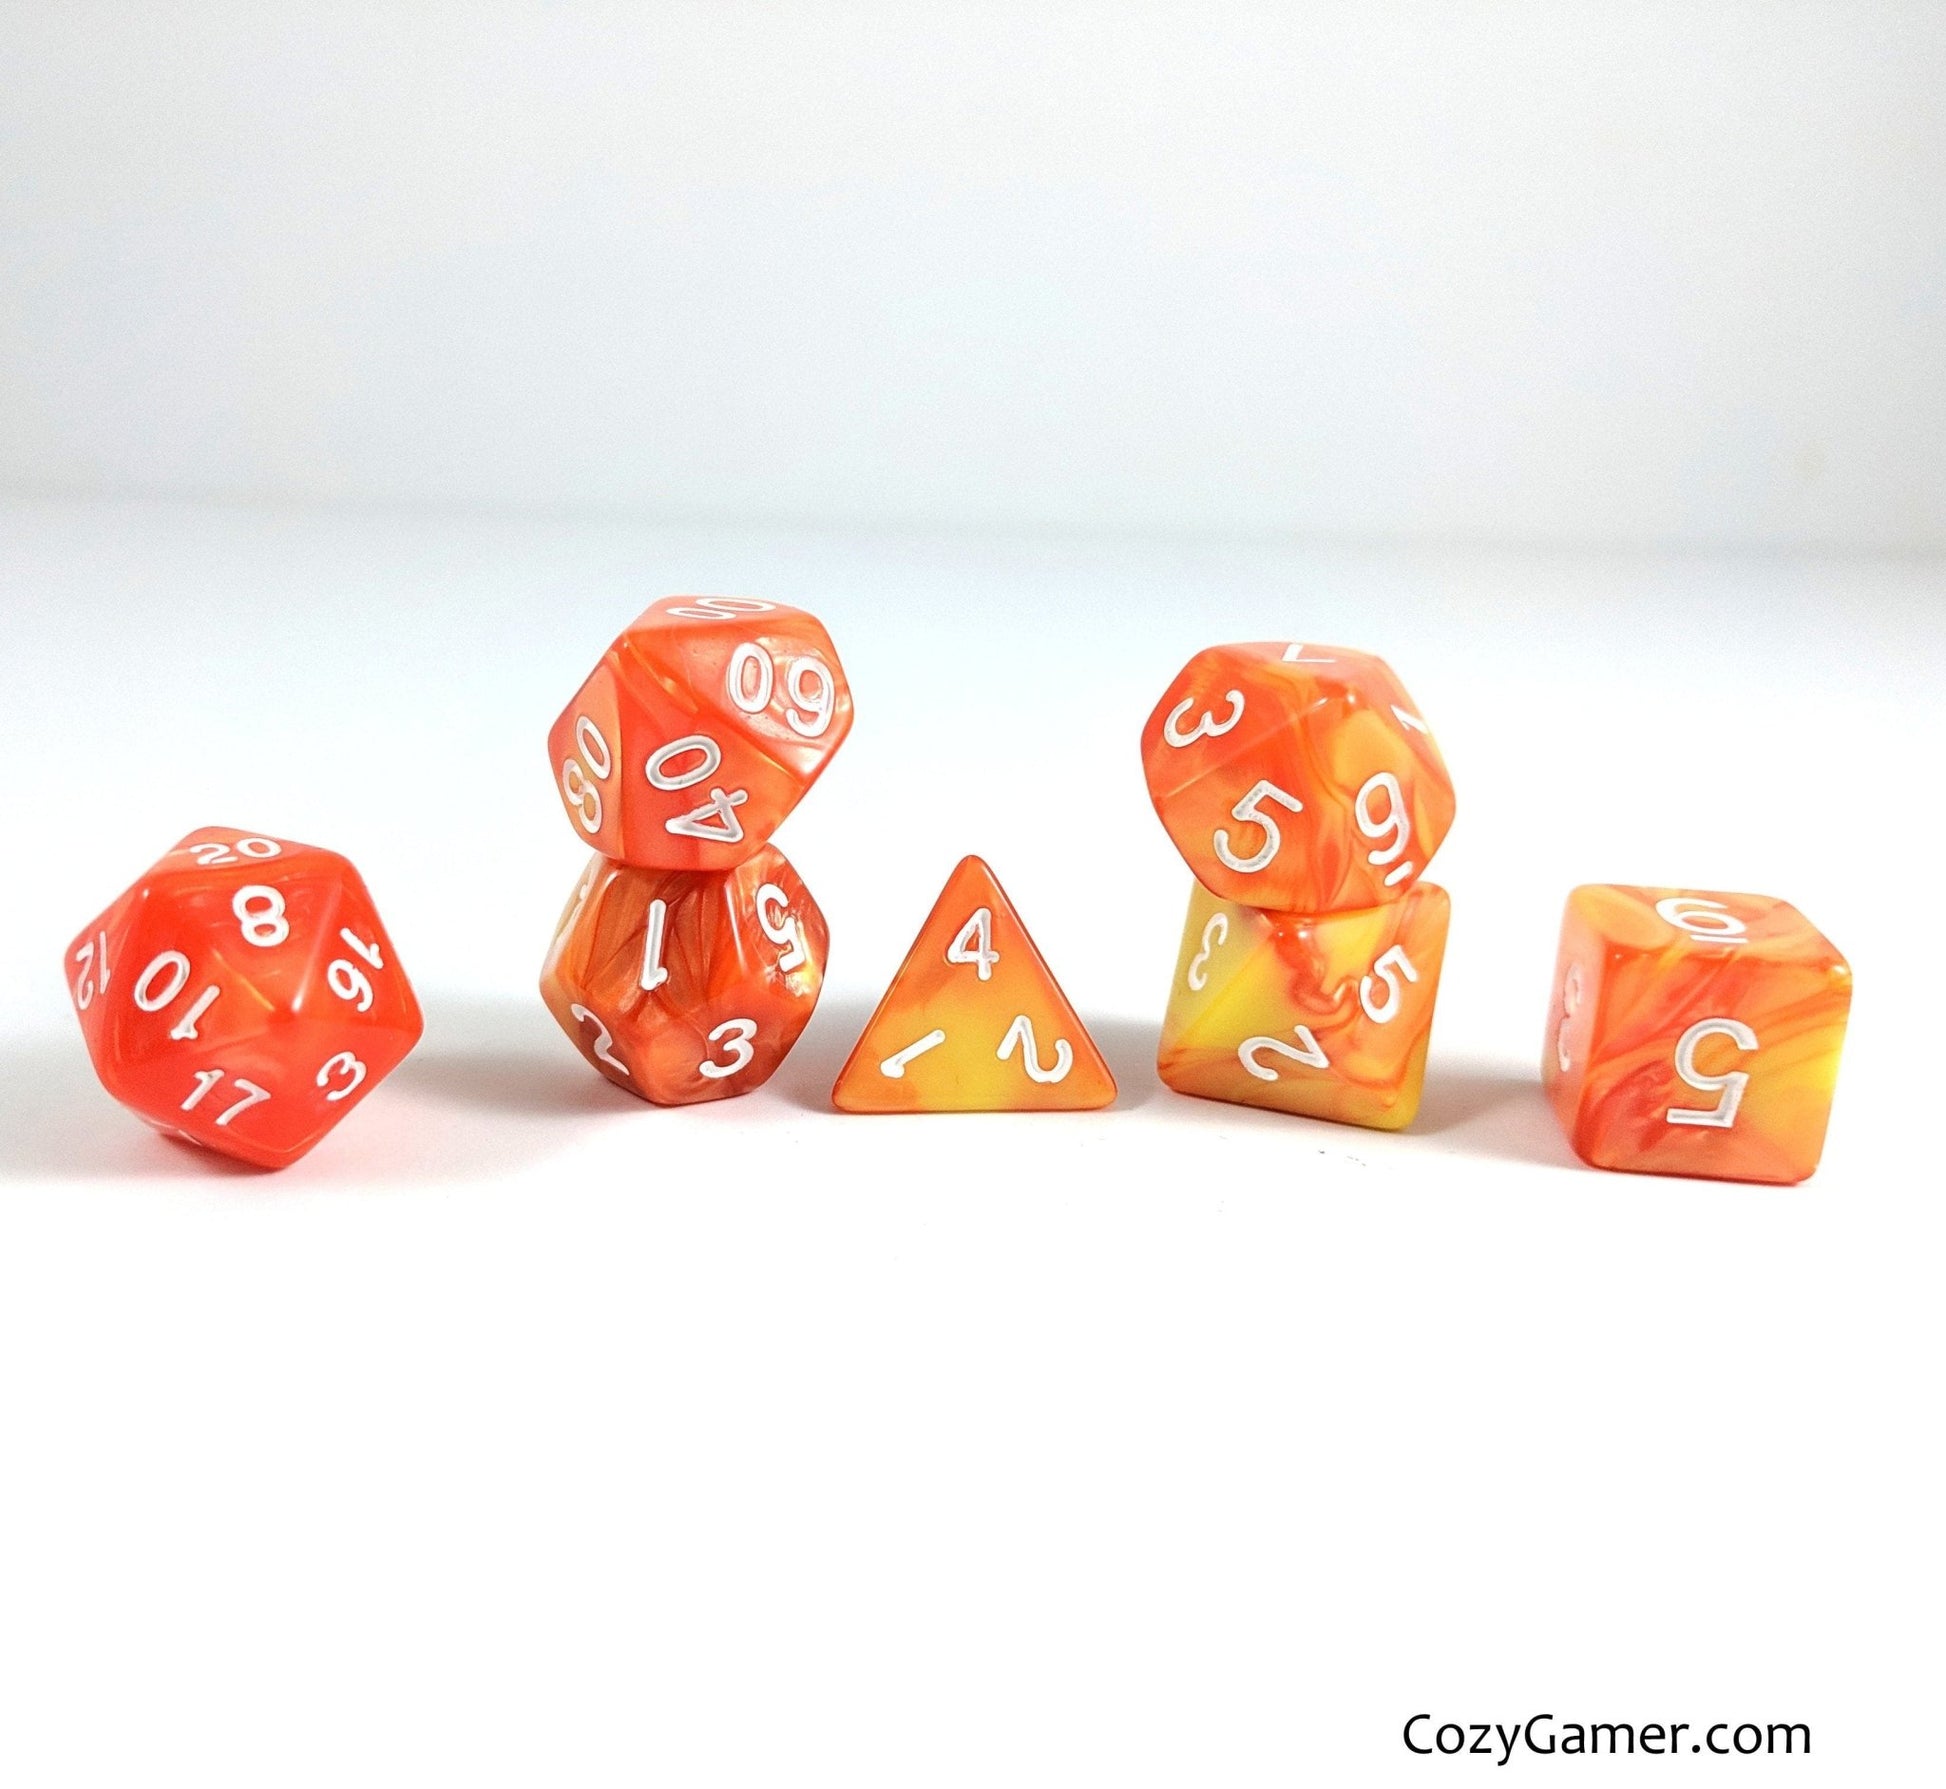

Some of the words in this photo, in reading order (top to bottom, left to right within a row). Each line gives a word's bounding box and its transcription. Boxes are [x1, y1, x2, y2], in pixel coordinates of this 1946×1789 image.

[1163, 689, 1245, 748] 3
[562, 715, 612, 834] 80
[645, 734, 748, 843] 40
[190, 837, 282, 865] 20
[1213, 779, 1304, 873] 5
[232, 884, 290, 947] 8
[640, 899, 668, 991] 1
[756, 883, 807, 973] 5
[947, 907, 1000, 981] 4
[1187, 912, 1229, 991] 3
[76, 931, 111, 1010] 12
[134, 950, 220, 1040] 10
[1359, 944, 1419, 1023] 5
[316, 1051, 367, 1102] 3
[570, 1003, 630, 1076] 2
[699, 1017, 758, 1079] 3
[880, 1029, 946, 1079] 1
[996, 1014, 1074, 1083] 2
[1237, 1024, 1330, 1081] 2
[1666, 1016, 1759, 1128] 5
[180, 1068, 272, 1126] 17
